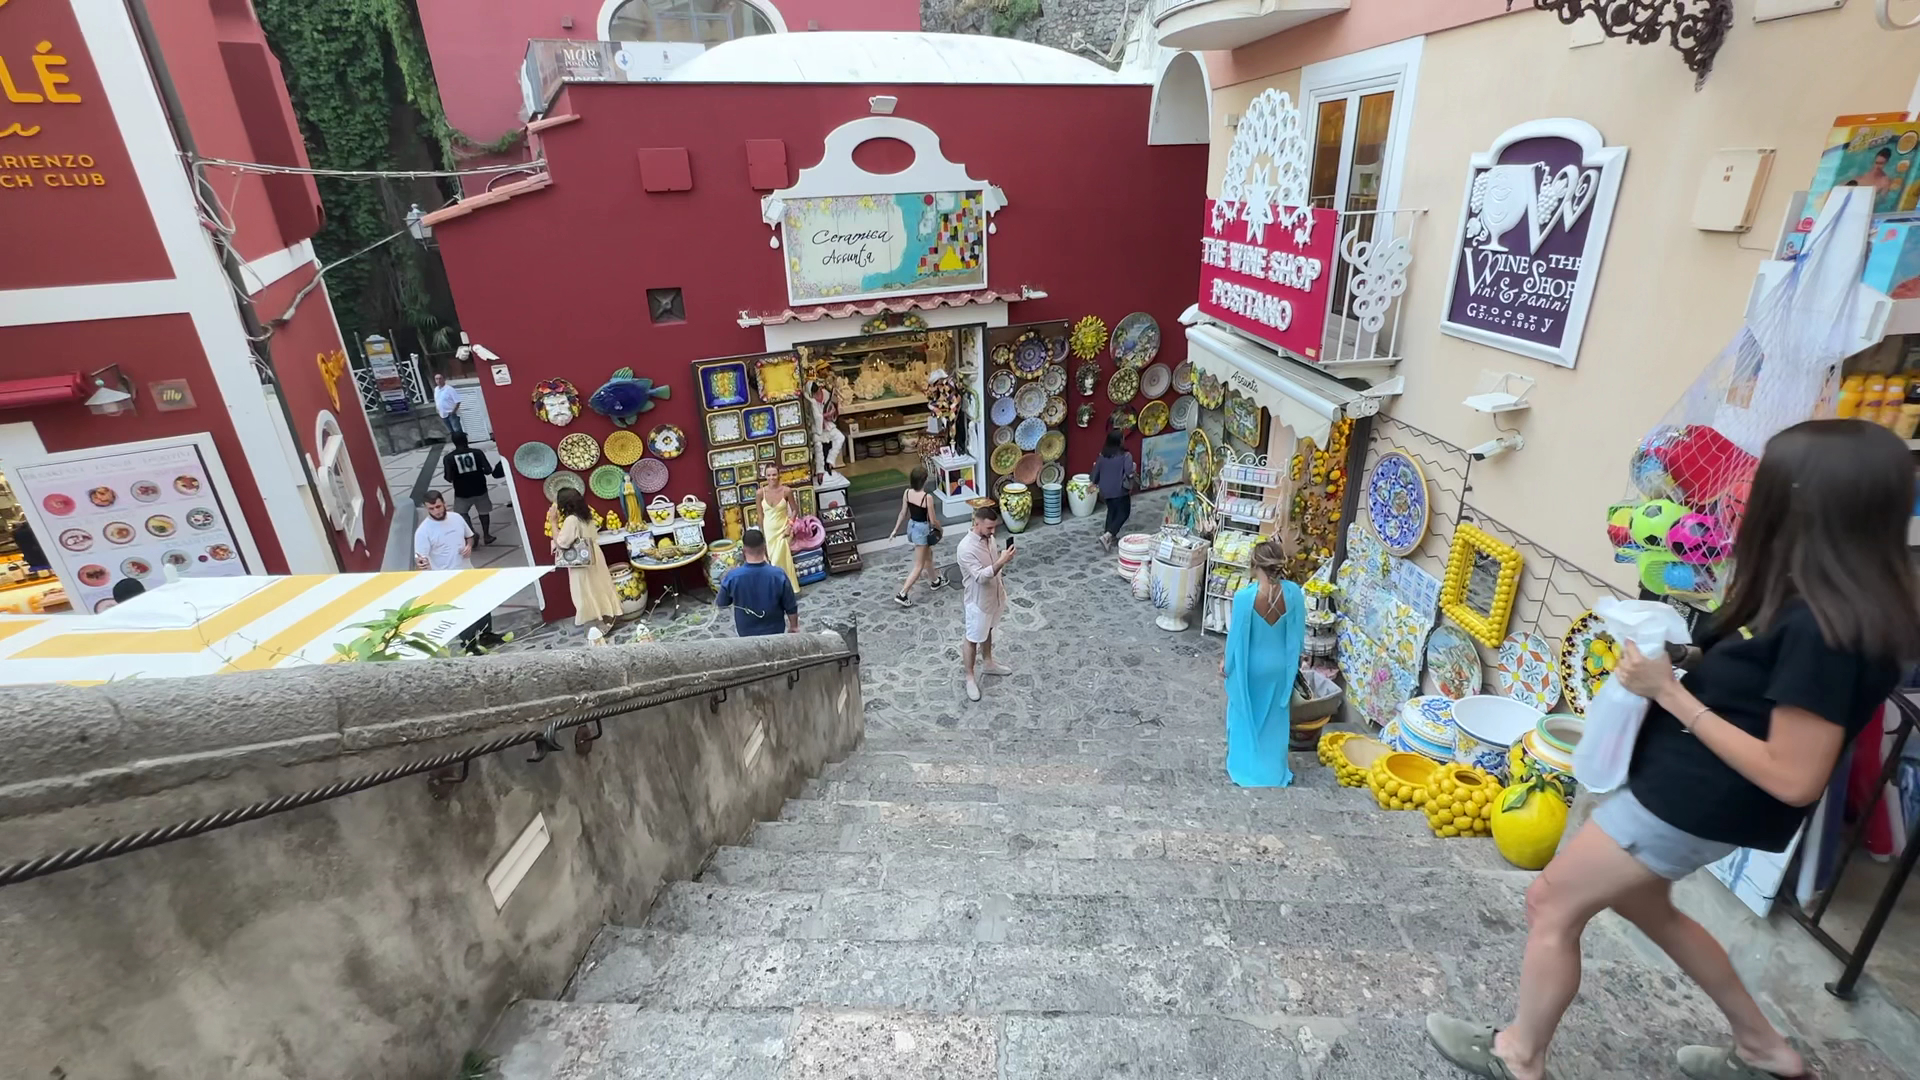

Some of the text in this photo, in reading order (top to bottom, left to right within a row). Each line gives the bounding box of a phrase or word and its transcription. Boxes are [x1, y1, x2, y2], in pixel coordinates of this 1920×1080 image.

[0, 154, 94, 169] RIENZO
[44, 172, 106, 187] CLUB
[811, 229, 894, 246] Ceramica
[822, 243, 876, 268] Assunta
[1202, 236, 1322, 292] THE WINE SHOP
[1549, 254, 1583, 271] THE
[1464, 247, 1578, 299] WINE SHOP
[1210, 277, 1293, 332] POSITANO
[1499, 277, 1519, 304] &
[1515, 292, 1570, 313] panini
[1466, 303, 1555, 333] Grocery
[1477, 312, 1507, 325] Since
[456, 454, 476, 470] 10
